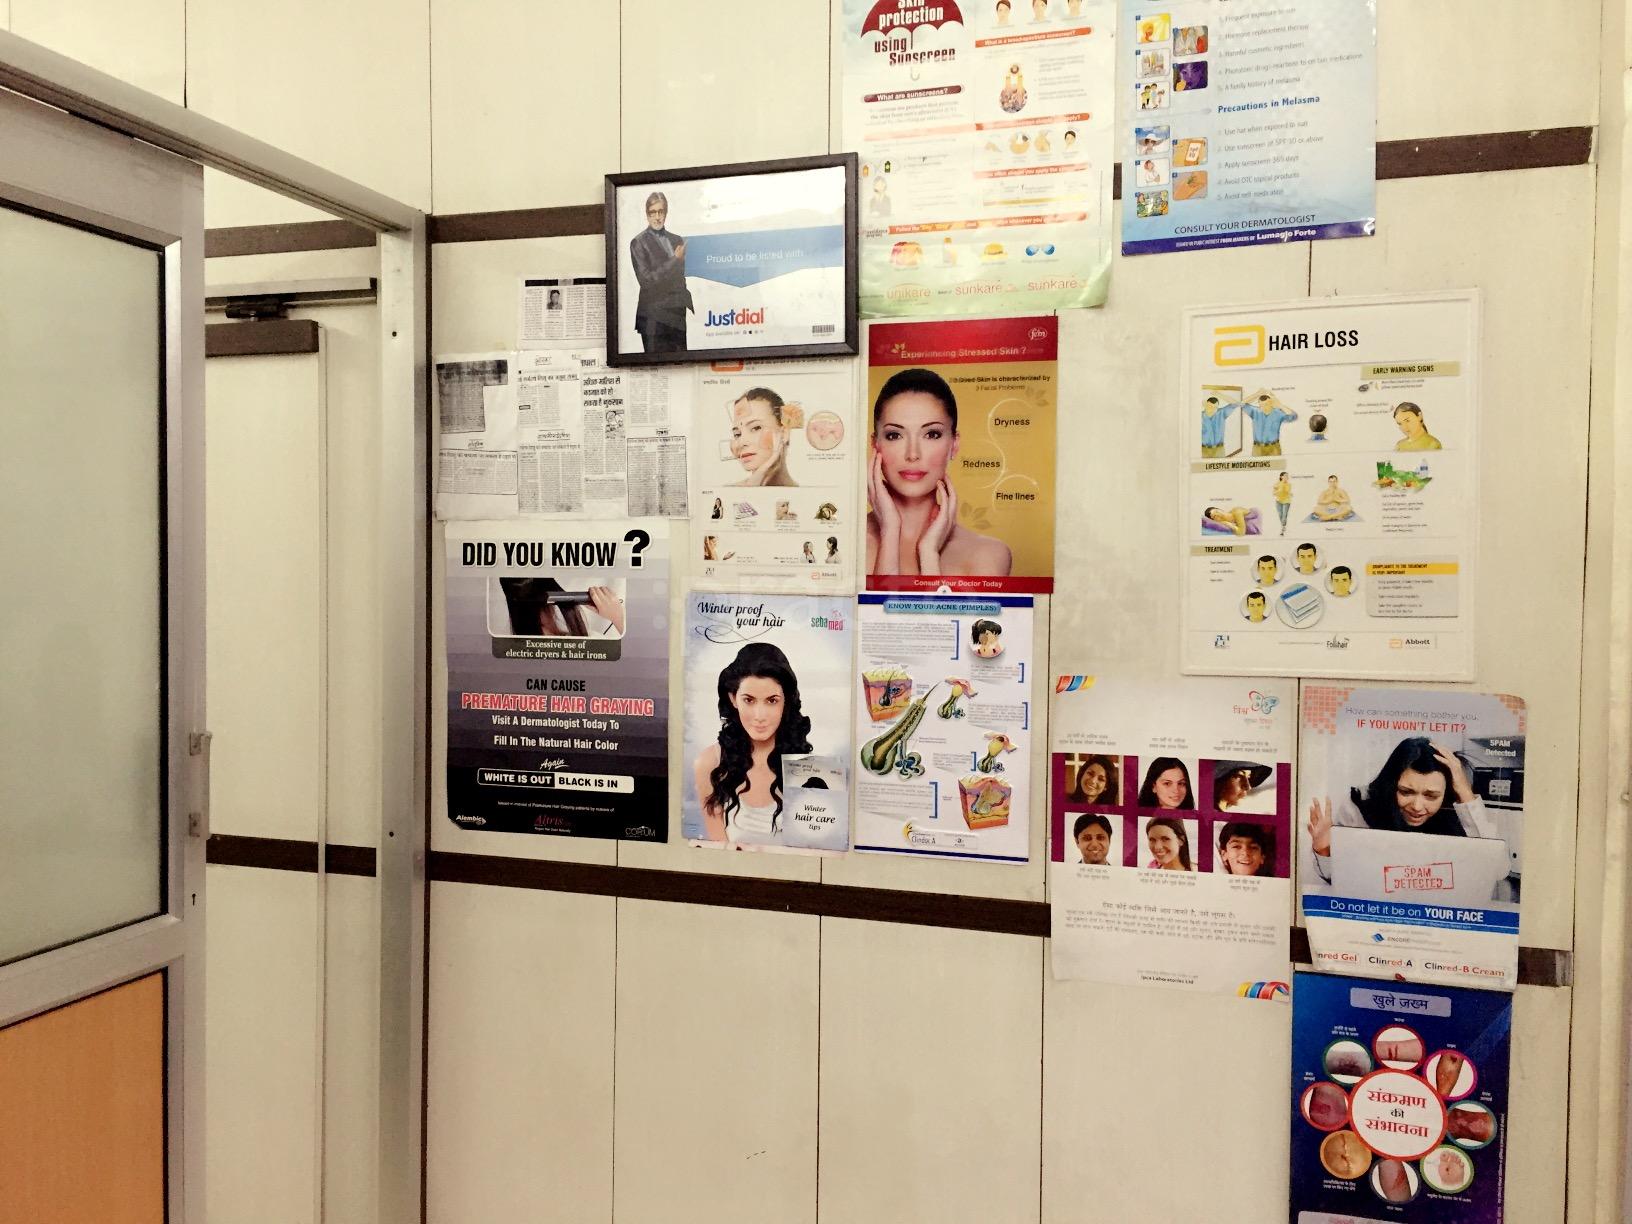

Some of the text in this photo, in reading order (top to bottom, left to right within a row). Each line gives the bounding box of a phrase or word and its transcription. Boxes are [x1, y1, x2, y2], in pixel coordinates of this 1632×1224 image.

[878, 7, 944, 30] protection
[874, 37, 908, 53] using
[889, 48, 956, 67] Sunscreen
[877, 93, 893, 102] What
[1217, 101, 1268, 115] Precautions
[1281, 95, 1321, 107] Melasma
[1174, 214, 1316, 234] CONSULT YOUR DERMATOLOGIST
[1294, 229, 1317, 237] Forte
[706, 254, 733, 264] Proud
[734, 253, 744, 263] to
[745, 252, 757, 262] be
[758, 250, 783, 261] listed
[886, 276, 1078, 301] unikare sunkare sunkare
[704, 306, 764, 327] Justdial
[1269, 330, 1359, 351] HAIR LOSS
[900, 346, 1019, 360] Experiencing Stressed Skin
[1372, 365, 1435, 375] EARLY WARNING SIGNS
[994, 417, 1031, 428] Dryness
[963, 460, 1001, 468] Redness
[1231, 461, 1271, 470] MODIFICATIONS
[996, 492, 1036, 501] Fine lines
[462, 542, 496, 567] DID
[503, 542, 543, 567] YOU
[551, 542, 617, 567] KNOW
[1204, 546, 1234, 554] TREATMENT
[914, 579, 940, 587] Consult
[958, 580, 981, 588] Doctor
[983, 580, 1003, 589] Today
[697, 601, 765, 618] Winter proof
[888, 602, 997, 613] KNOW YOUR ACNE (PIMPLES)
[736, 615, 786, 629] your hair
[526, 640, 587, 650] Excessive use of
[1405, 638, 1431, 646] Abbott
[505, 649, 607, 660] electric dryers & hair irons
[526, 678, 586, 692] CAN CAUSE
[461, 692, 655, 717] PREMATURE HAIR GRAYING
[1345, 706, 1459, 719] How can something bother
[492, 714, 620, 732] Visit A Dermatologist Today To
[1357, 718, 1467, 733] IF YOU WON'T LET IT?
[494, 735, 619, 751] Fill In The Natural Hair Color
[1489, 739, 1511, 748] SPAM
[1485, 748, 1517, 758] Detected
[539, 757, 566, 770] Again
[484, 772, 619, 789] WHITE IS OUT BLACK IS IN
[803, 803, 827, 813] Winter
[455, 814, 482, 822] Alembic
[795, 812, 837, 824] hair care
[808, 821, 822, 831] tips
[1403, 866, 1432, 879] SPAM
[1330, 899, 1484, 923] Do not let it be on YOUR FACE
[1340, 953, 1357, 963] Gel
[1368, 956, 1403, 967] Clinred
[1405, 959, 1413, 968] A
[1424, 962, 1470, 974] Clinred-B
[1472, 967, 1505, 977] Cream
[1372, 994, 1395, 1009] खुले
[1367, 1088, 1427, 1109] संक्रमण
[1390, 1107, 1405, 1119] की
[1364, 1116, 1430, 1138] संभावना
